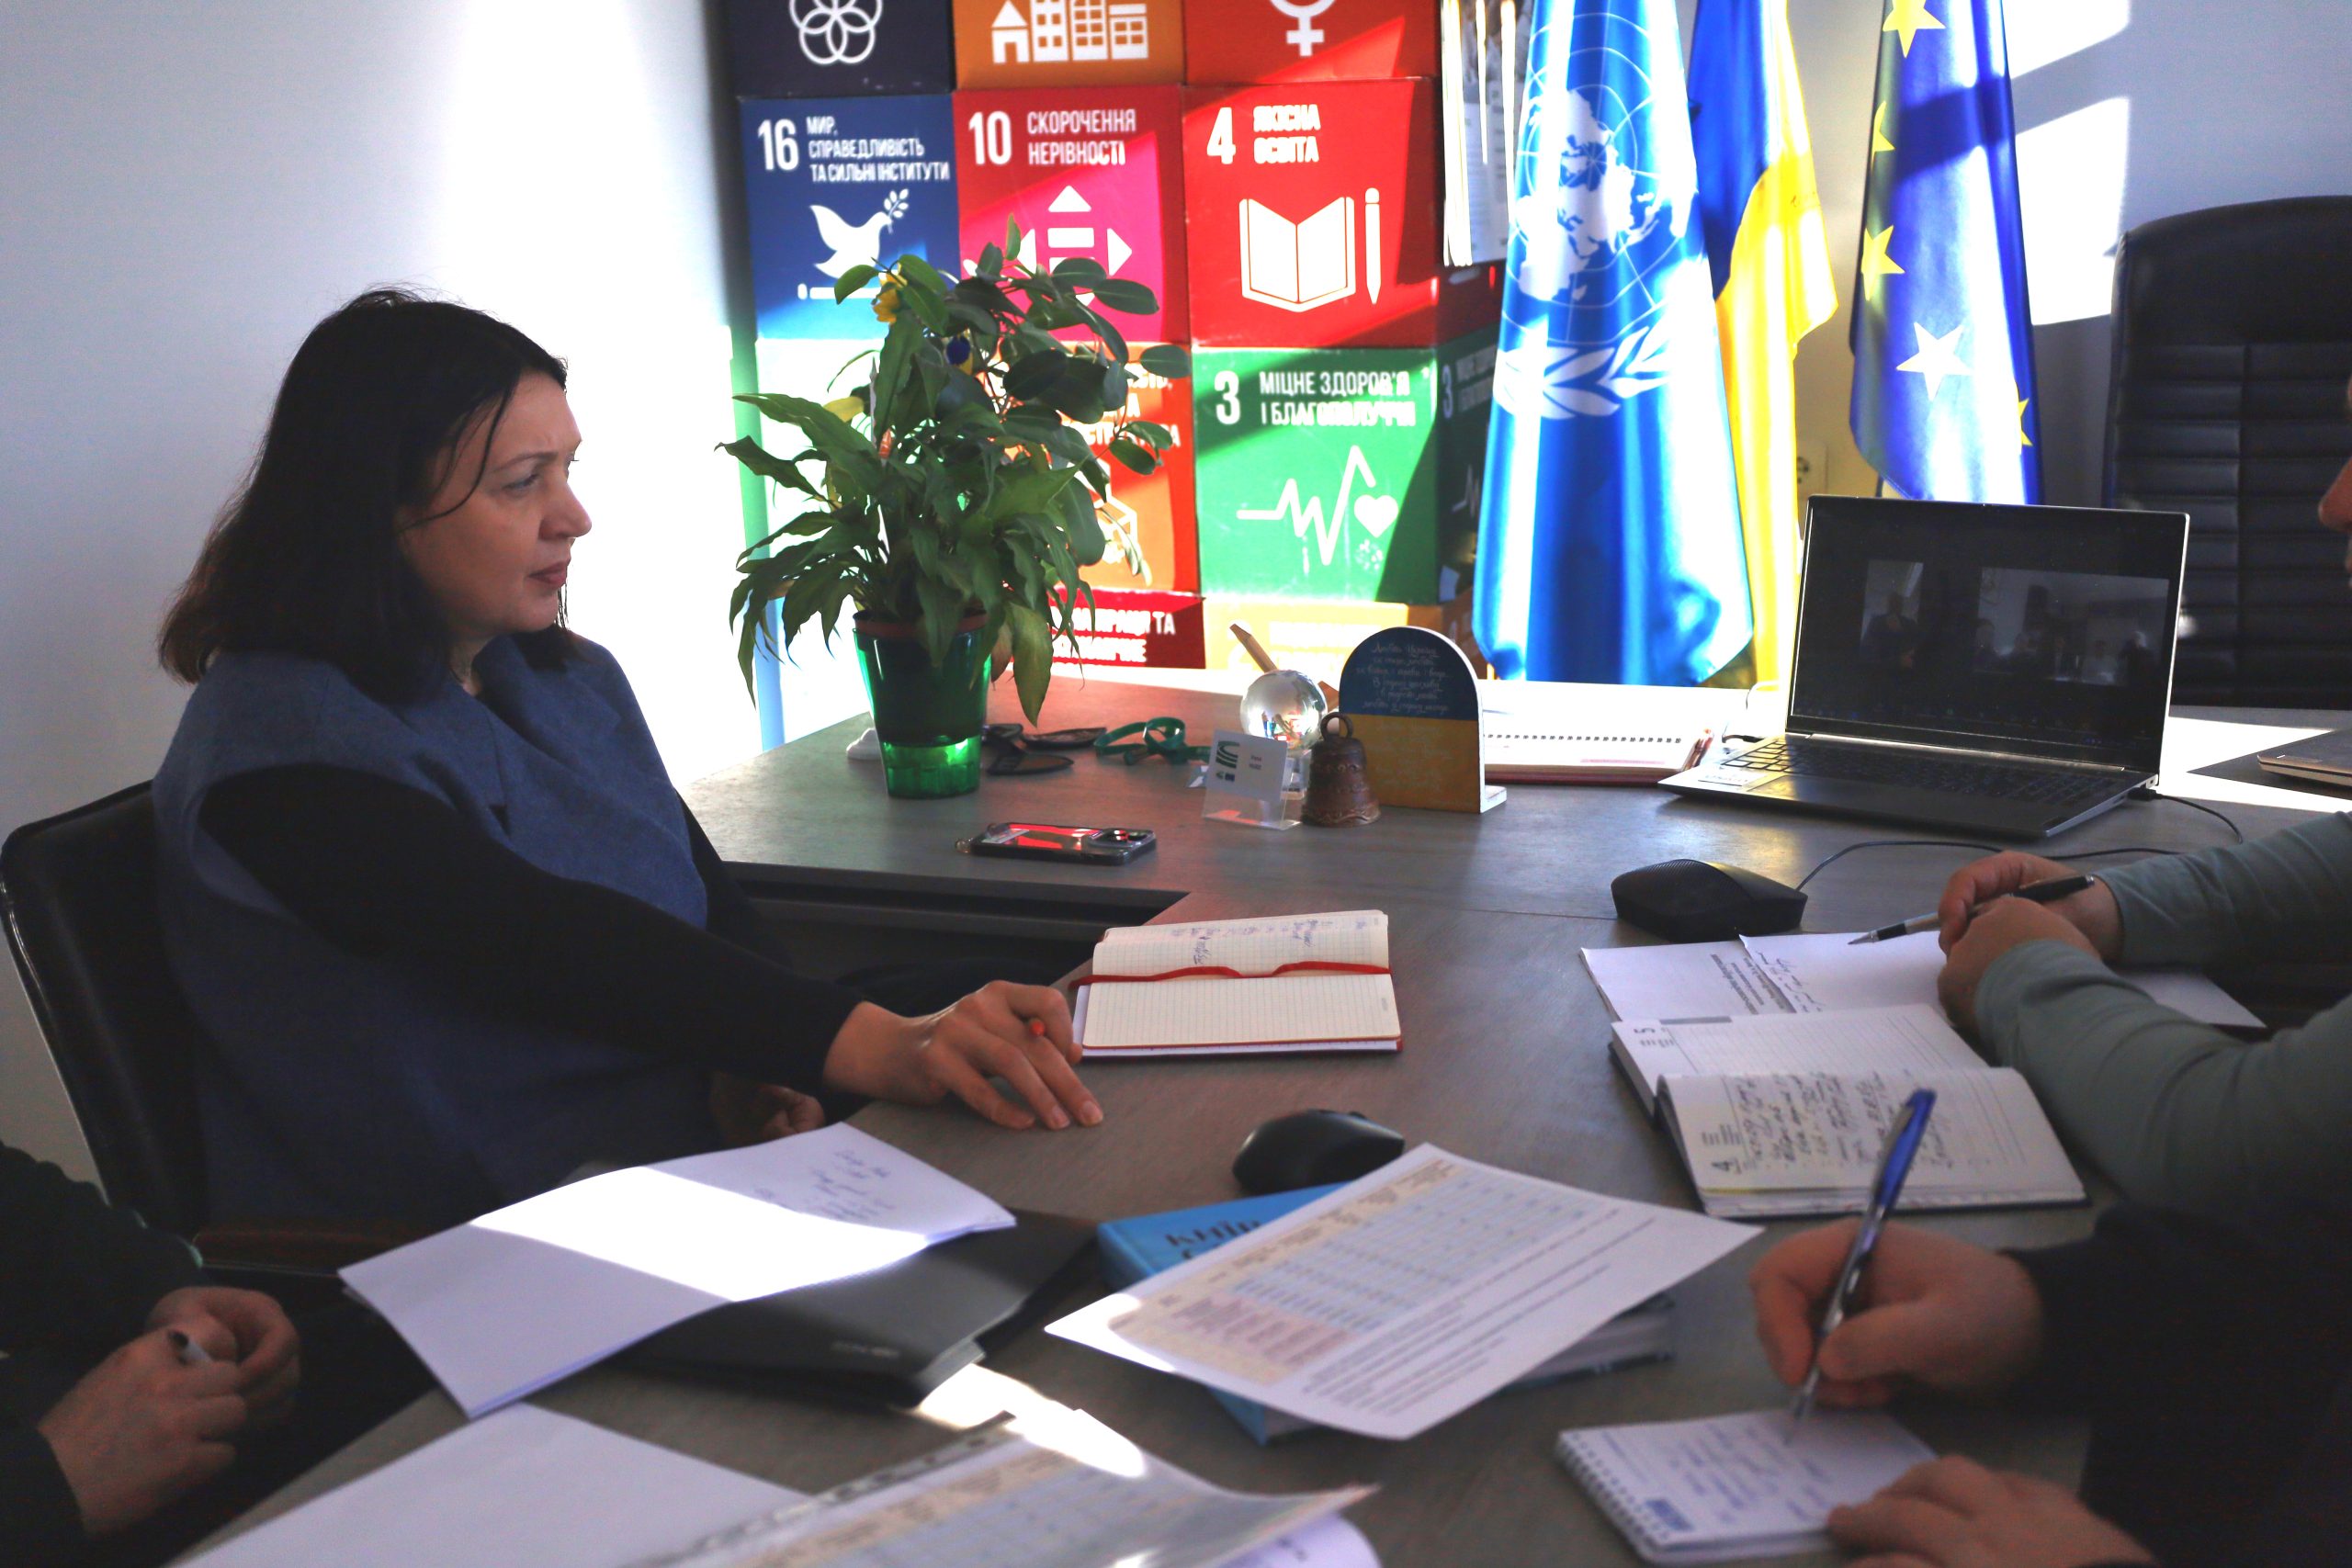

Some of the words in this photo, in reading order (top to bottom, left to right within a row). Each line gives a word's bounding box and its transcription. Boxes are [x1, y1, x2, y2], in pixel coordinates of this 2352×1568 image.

[806, 116, 839, 136] МИР,
[1026, 108, 1137, 135] СКОРОЧЕННЯ
[1253, 104, 1321, 132] ЯКІСНА
[758, 118, 799, 171] 16
[808, 138, 925, 159] СПРАВЕДЛИВІСТЬ
[968, 110, 1012, 165] 10
[1206, 107, 1237, 164] 4
[1028, 140, 1126, 166] НЕРІВНОСТІ
[1253, 136, 1320, 164] ОСВІТА
[810, 164, 827, 182] ТА
[828, 163, 876, 182] СИЛЬНІ
[877, 162, 951, 181] ІНСТИТУТИ
[1214, 370, 1241, 424] 3
[1259, 371, 1317, 397] МІЦНЕ
[1319, 371, 1410, 397] ЗДОРОВ'Я
[1261, 402, 1268, 424] І
[1152, 611, 1176, 635] ТА
